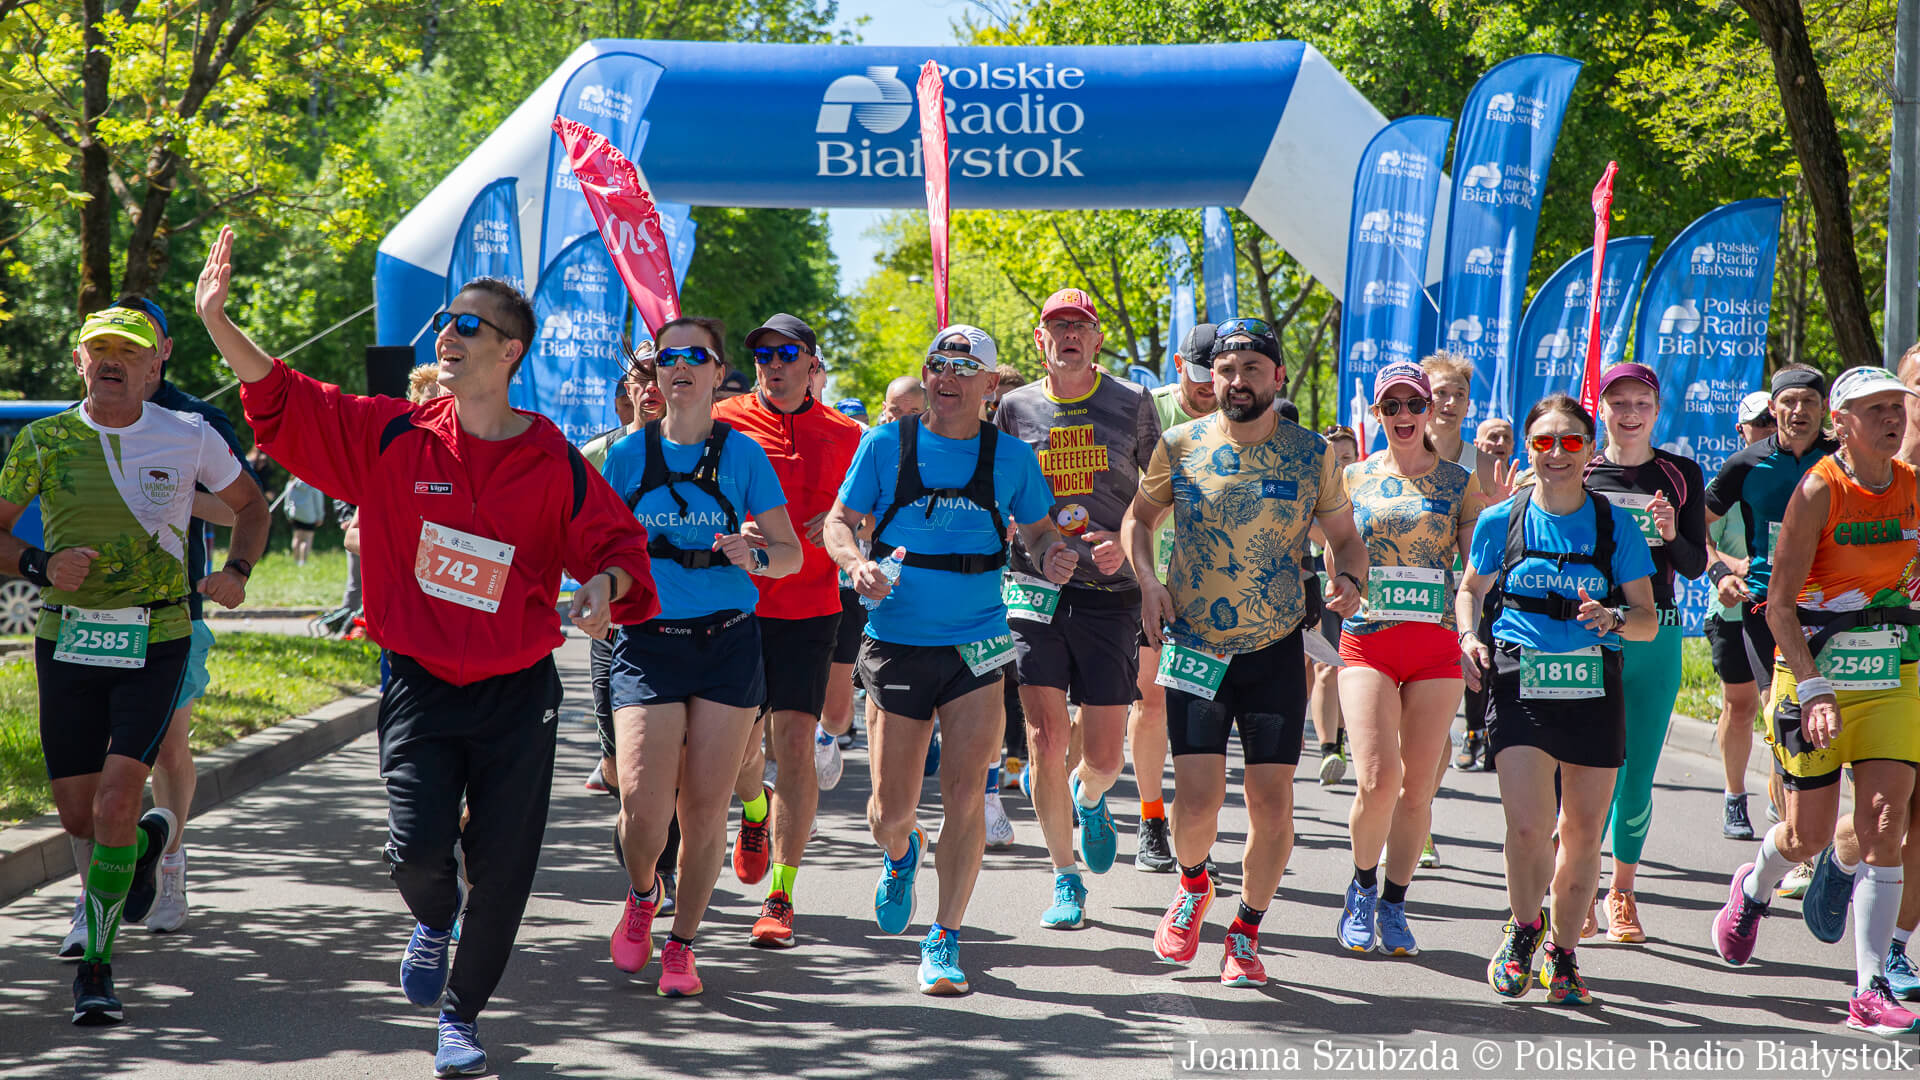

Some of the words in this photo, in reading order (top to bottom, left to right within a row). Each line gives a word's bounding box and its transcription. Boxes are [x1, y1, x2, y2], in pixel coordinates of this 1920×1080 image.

[1717, 242, 1760, 254] Polskie
[1716, 252, 1758, 266] Radio
[1704, 298, 1769, 315] Polskie
[1703, 316, 1768, 336] Radio
[1697, 435, 1746, 451] Polsk
[638, 511, 730, 527] PACEMAKE
[435, 555, 478, 586] 742
[1507, 574, 1604, 592] PACEMAKER
[1007, 590, 1044, 607] 2338
[1382, 587, 1430, 606] 1844
[73, 629, 129, 650] 2585
[1536, 662, 1588, 682] 1816
[1831, 656, 1885, 675] 2549
